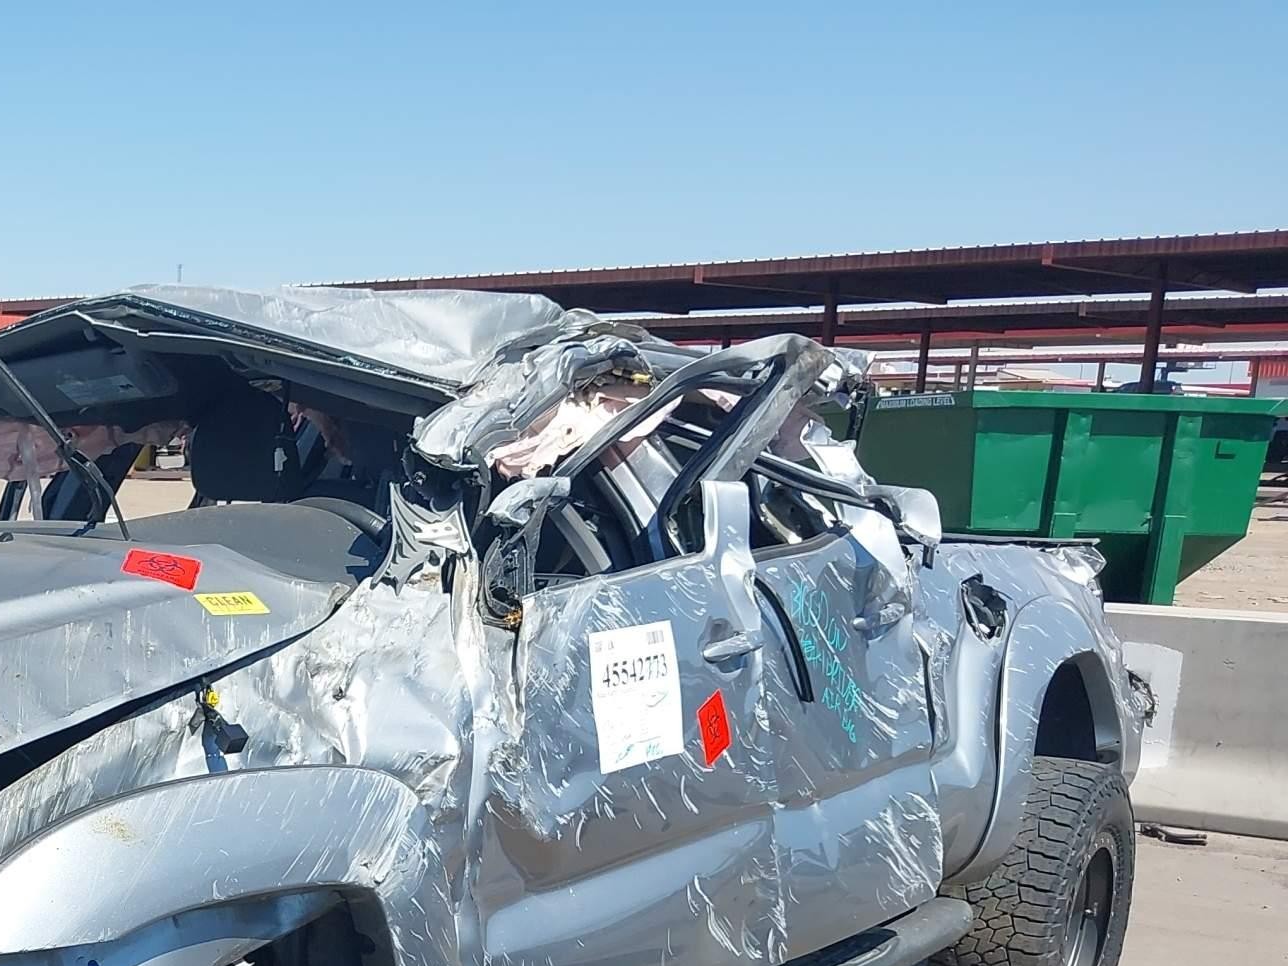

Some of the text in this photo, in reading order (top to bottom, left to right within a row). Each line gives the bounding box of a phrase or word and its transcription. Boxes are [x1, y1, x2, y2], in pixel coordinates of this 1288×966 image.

[907, 398, 932, 407] LOADING
[933, 397, 952, 406] LEVEL
[205, 595, 253, 607] CLEAN
[603, 653, 668, 688] 45542773
